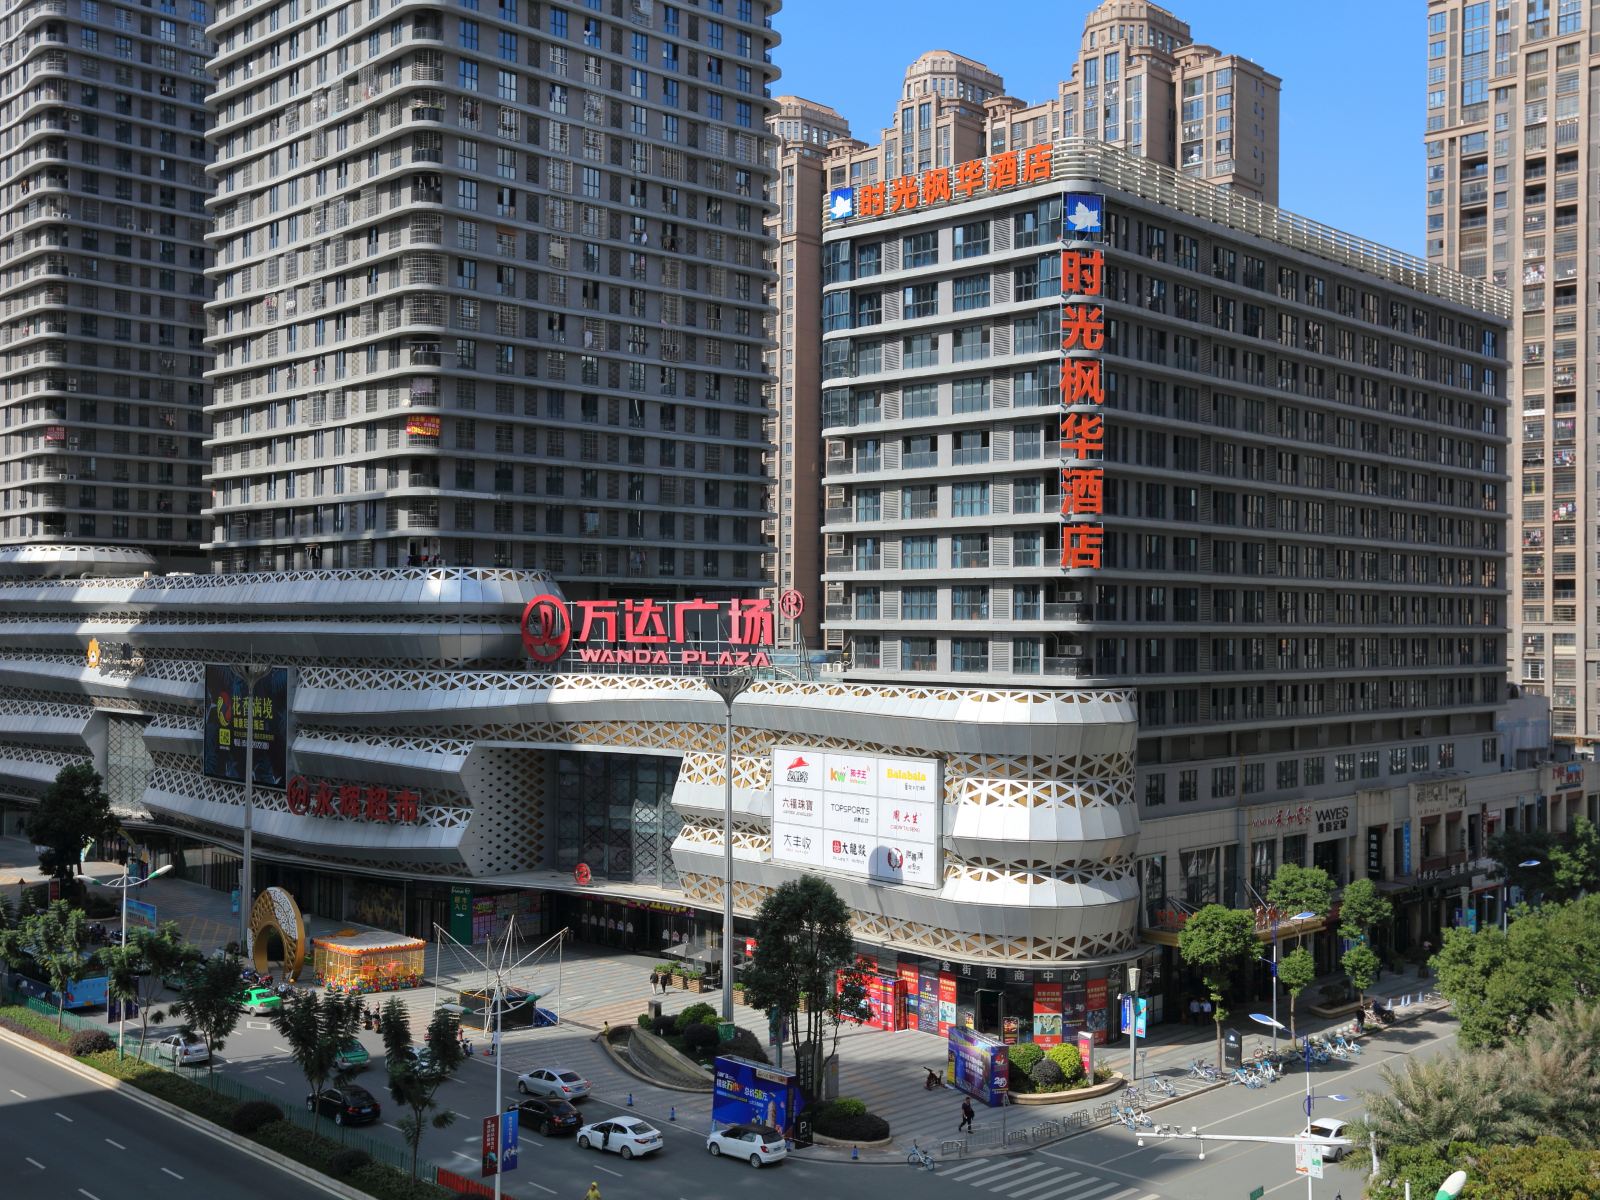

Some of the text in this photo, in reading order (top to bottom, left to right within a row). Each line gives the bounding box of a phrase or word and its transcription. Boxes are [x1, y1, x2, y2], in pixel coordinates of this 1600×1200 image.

[859, 143, 1053, 217] 时光枫华酒店
[1060, 250, 1105, 569] 时光枫华酒店
[576, 598, 775, 645] 万达广场
[579, 649, 771, 667] WANDA PLAZA
[886, 768, 927, 782] Balabala
[313, 781, 419, 822] 永辉超市
[782, 797, 814, 812] 六福珠寶
[831, 803, 870, 816] TOPSPORTS
[892, 809, 918, 824] 周大生
[1315, 806, 1349, 822] WAYES
[783, 833, 812, 850] 大丰收
[941, 960, 1081, 983] 金街招商中心
